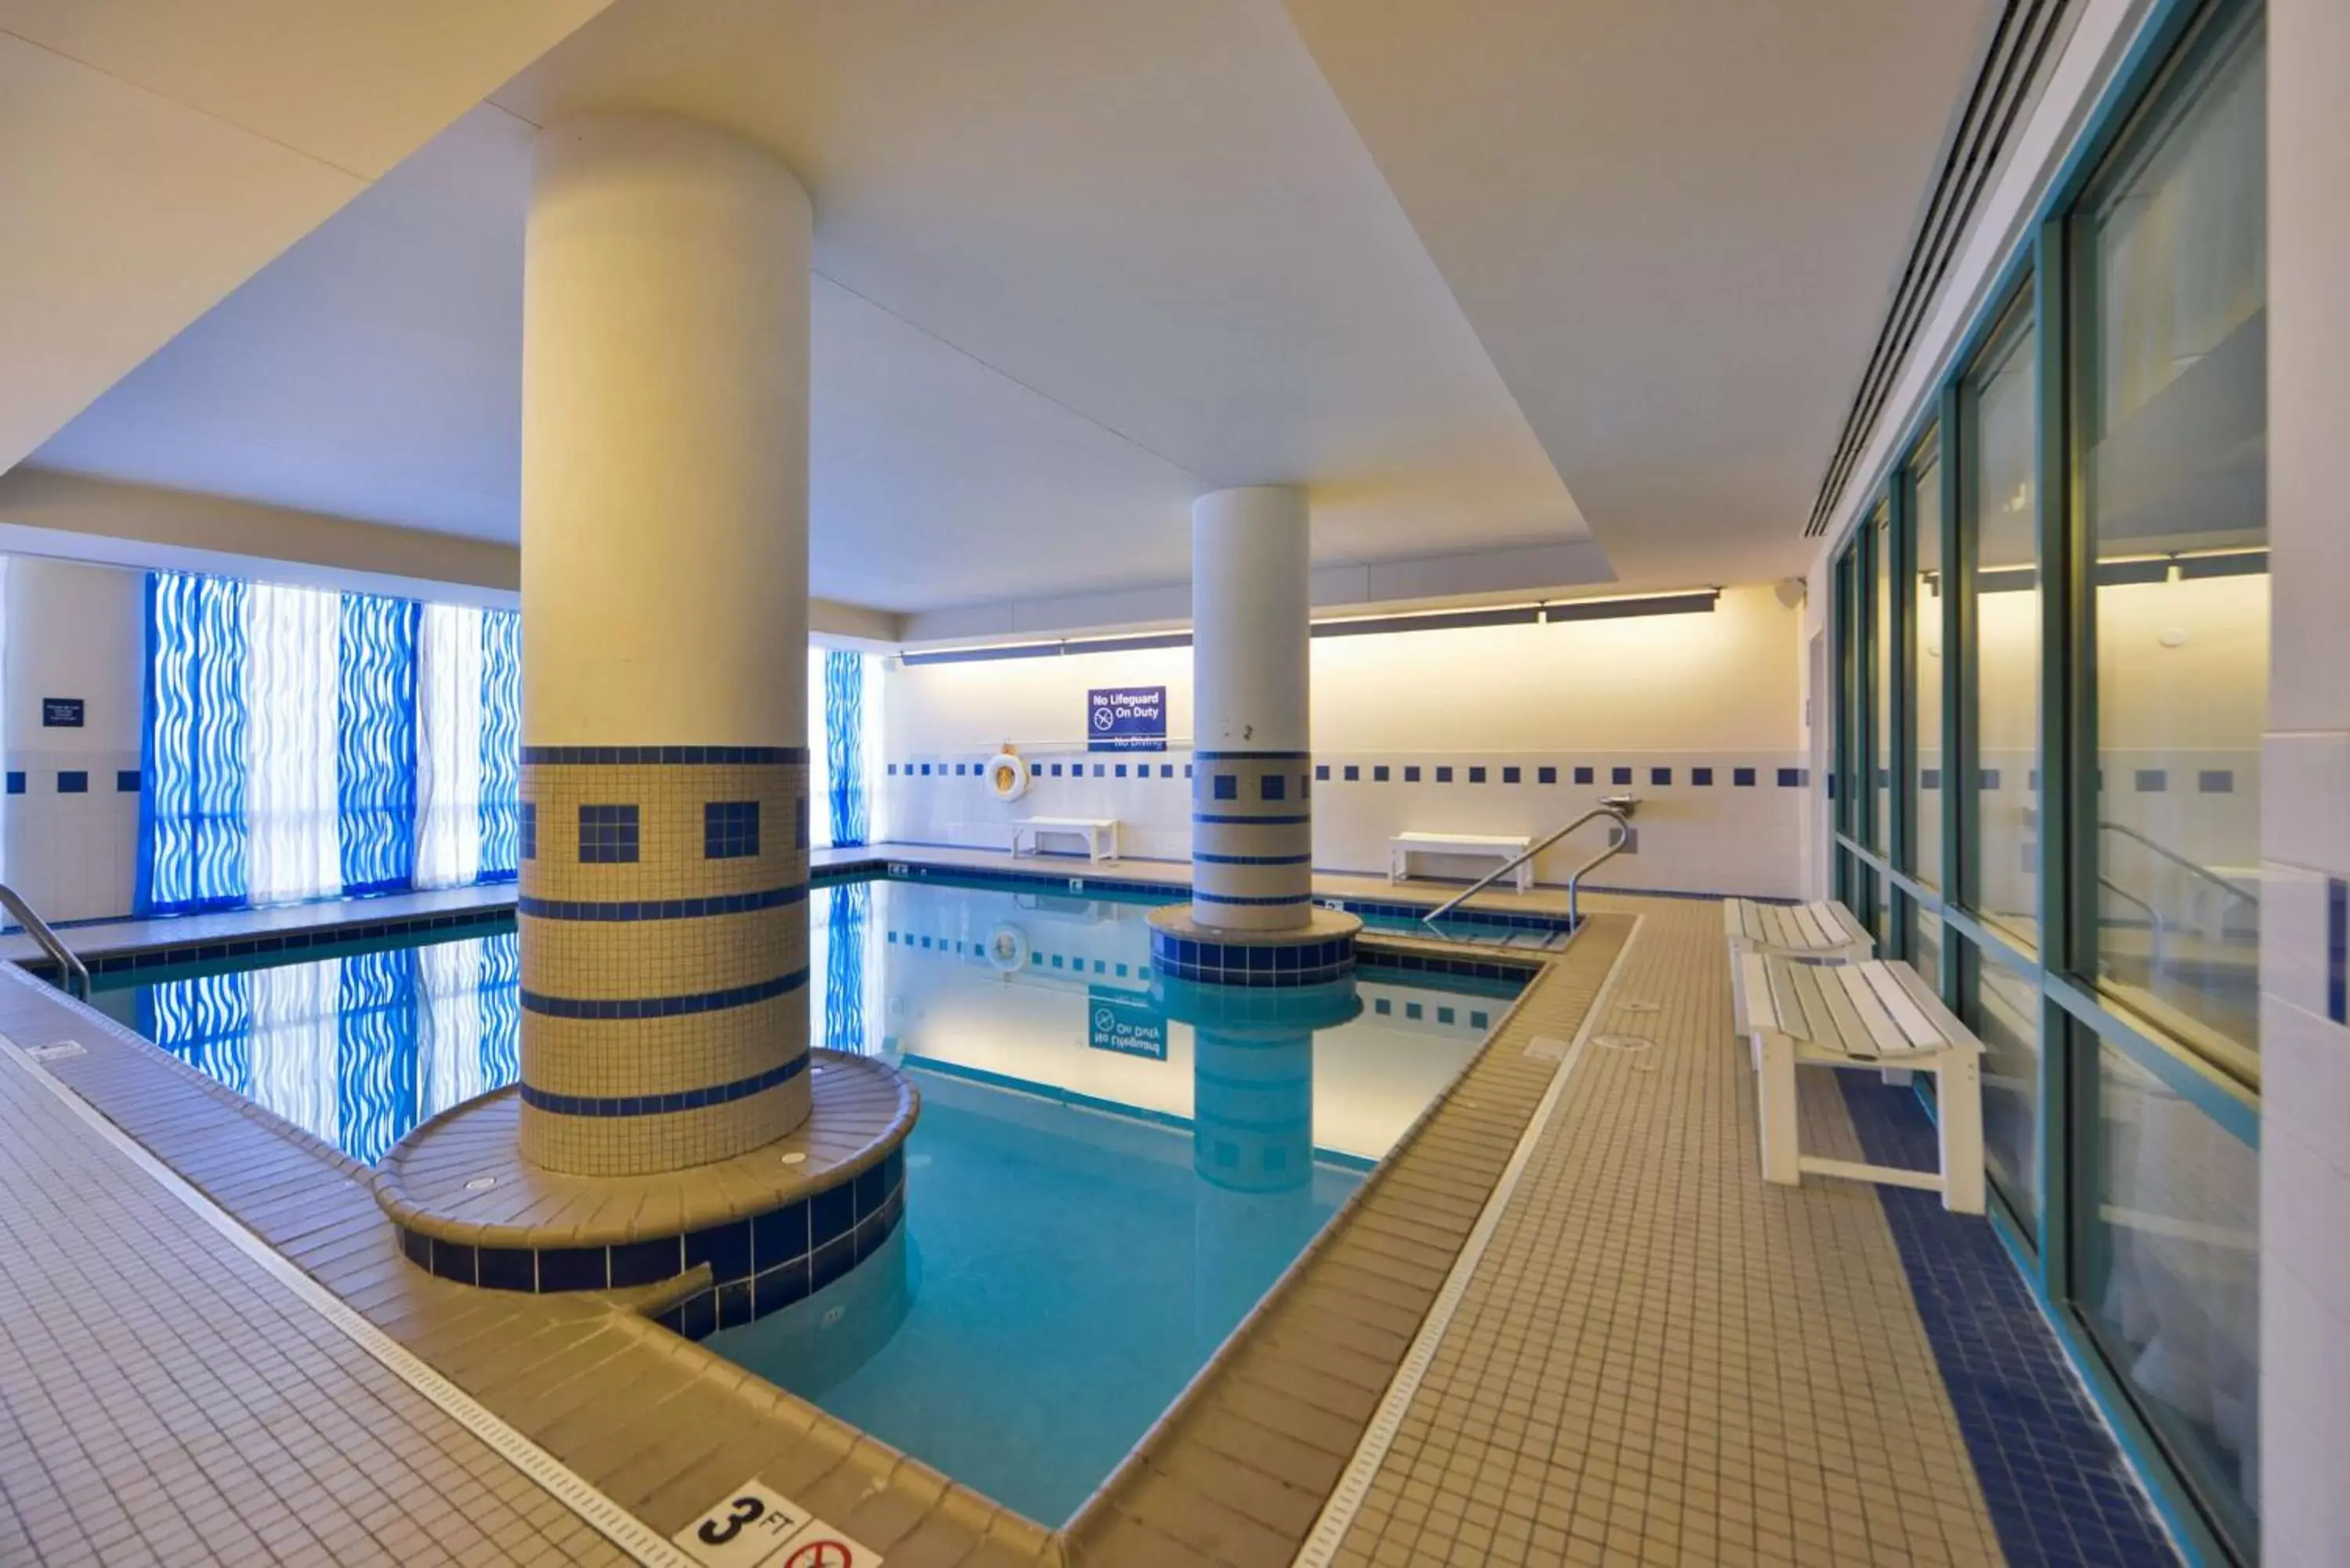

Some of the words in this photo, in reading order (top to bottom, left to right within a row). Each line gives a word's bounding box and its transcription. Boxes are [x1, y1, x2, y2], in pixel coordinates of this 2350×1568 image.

[1094, 695, 1108, 706] No
[1110, 692, 1159, 706] Lifeguard
[1115, 707, 1130, 717] On
[1133, 706, 1159, 720] Duty
[697, 1496, 765, 1545] 3
[758, 1511, 795, 1535] FT
